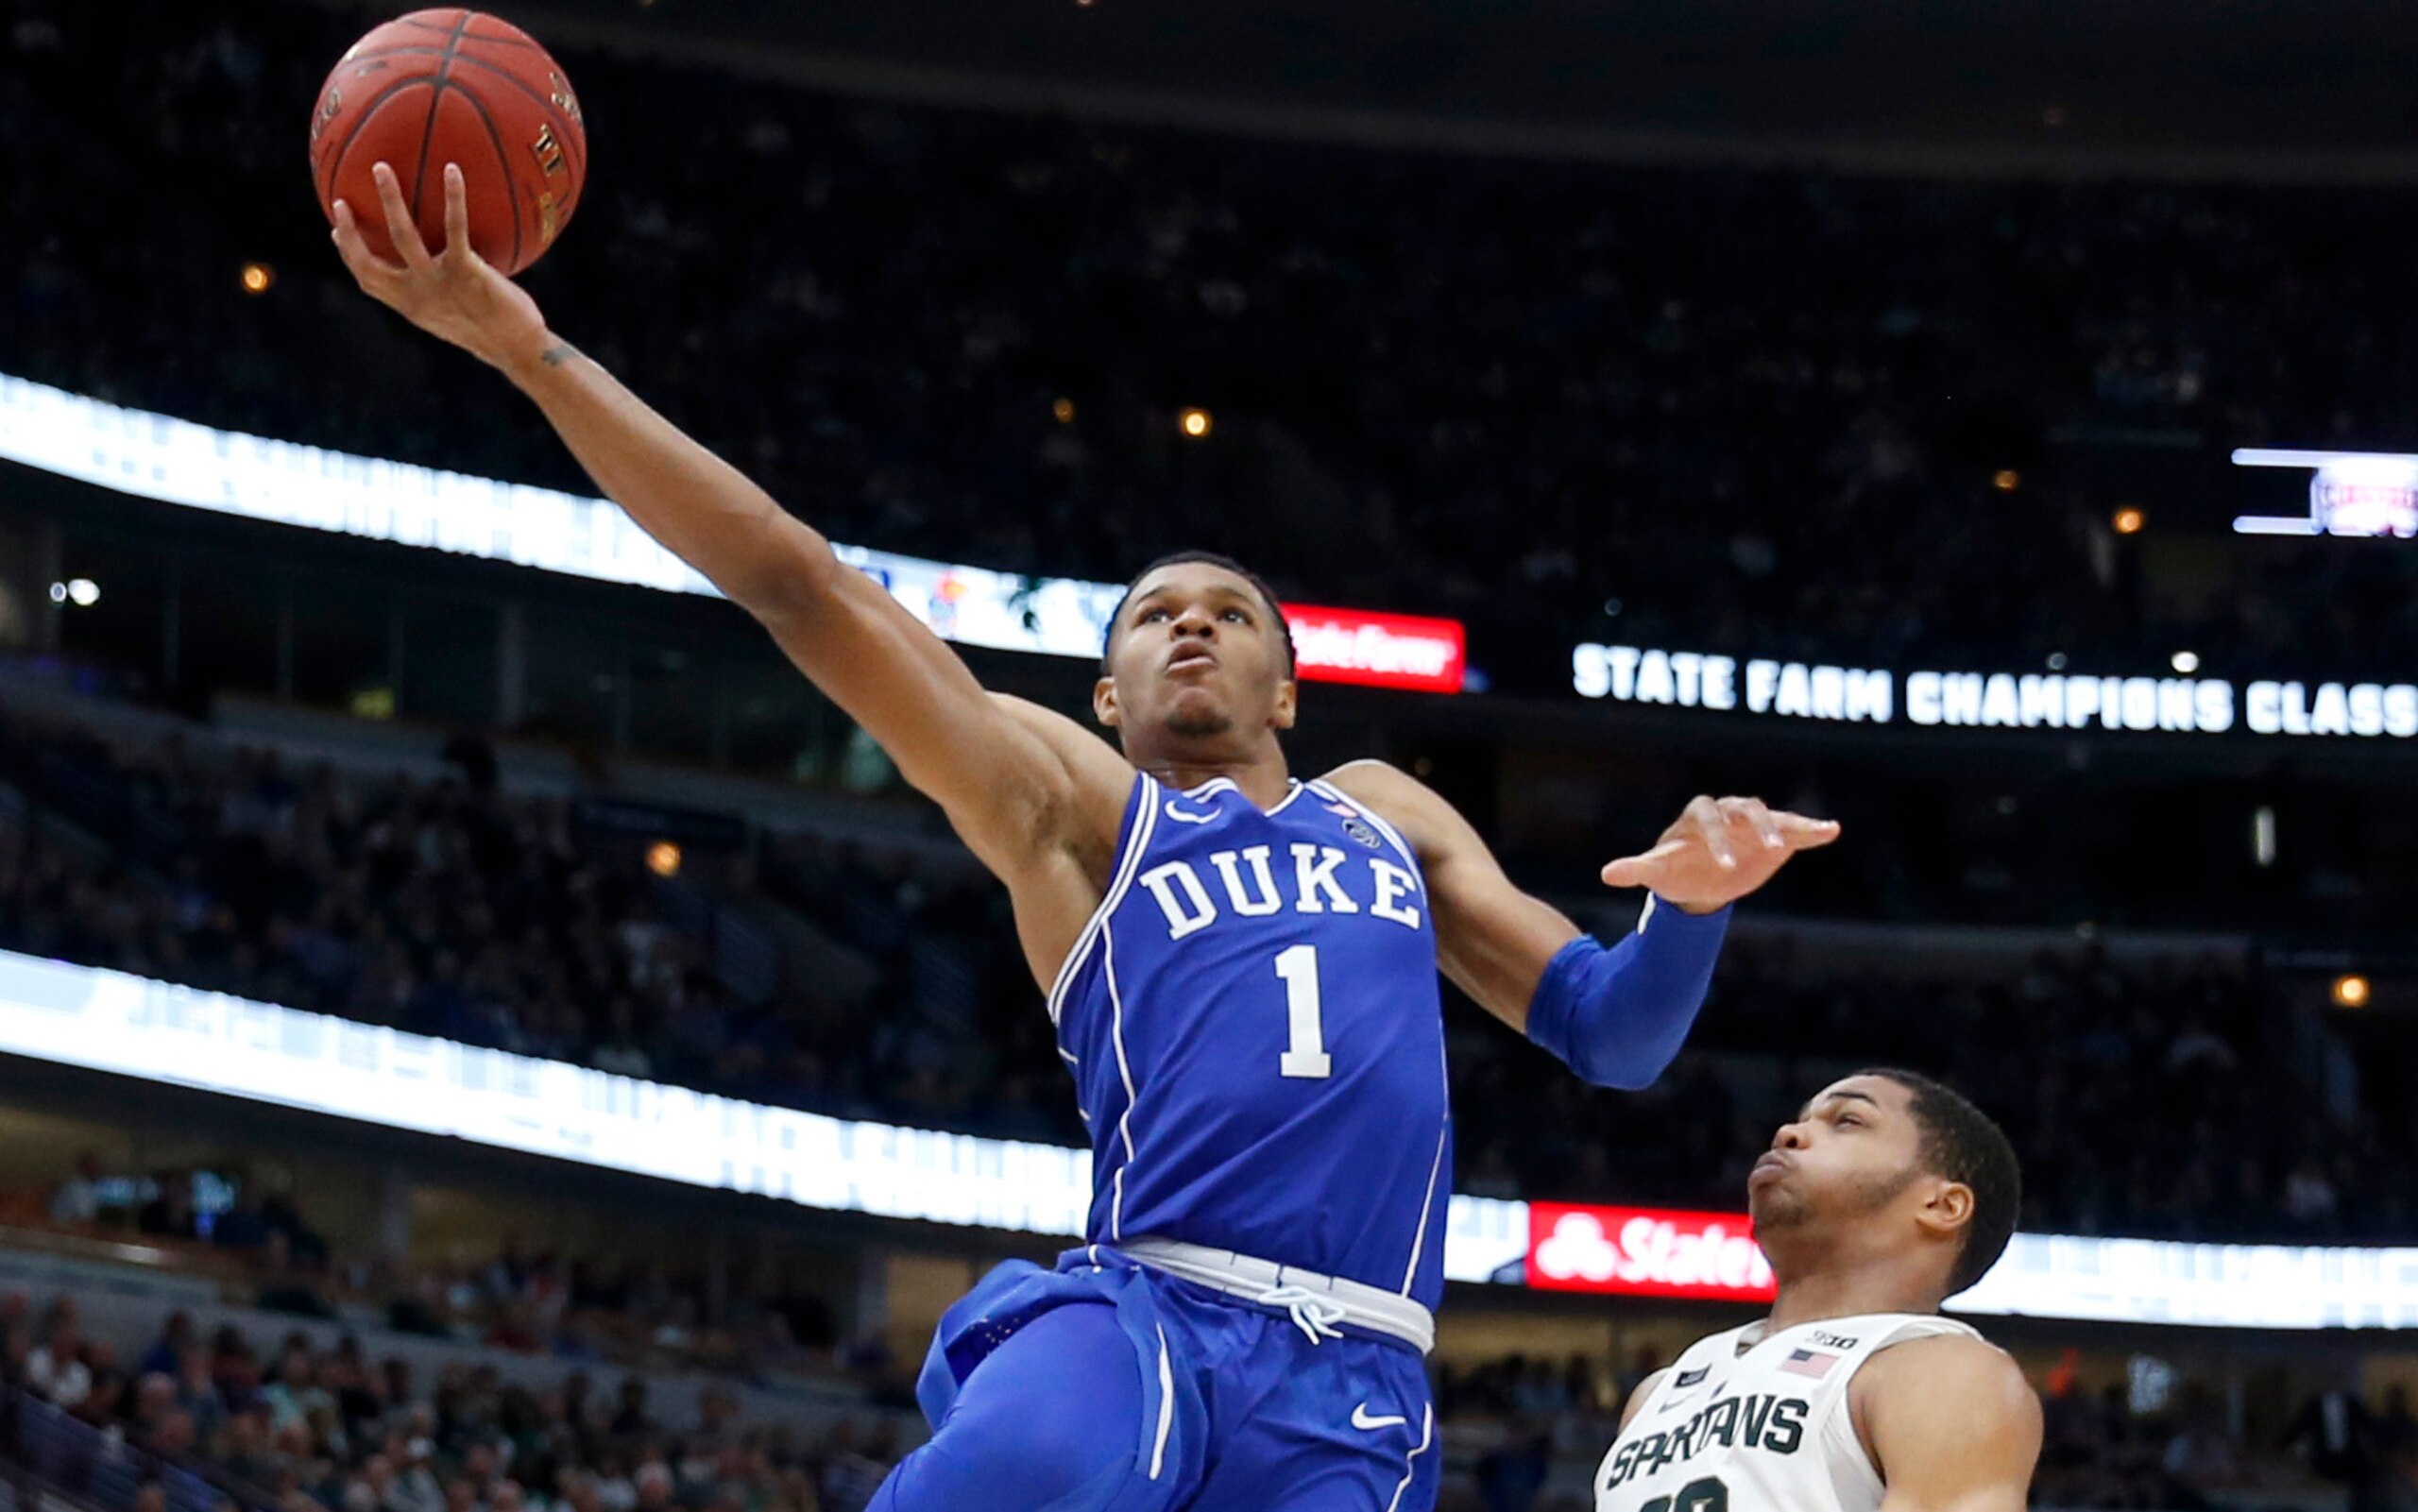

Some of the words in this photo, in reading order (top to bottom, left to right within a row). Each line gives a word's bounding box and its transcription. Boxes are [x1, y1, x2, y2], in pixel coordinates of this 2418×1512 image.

[1572, 642, 1737, 710] STATE
[1745, 658, 1893, 723] FARM
[1906, 671, 2234, 733] CHAMPIONS
[2246, 681, 2418, 737] CLASS
[1138, 843, 1421, 941] DUKE
[1274, 944, 1331, 1079] 1
[1607, 1393, 1810, 1491] SPARTANS
